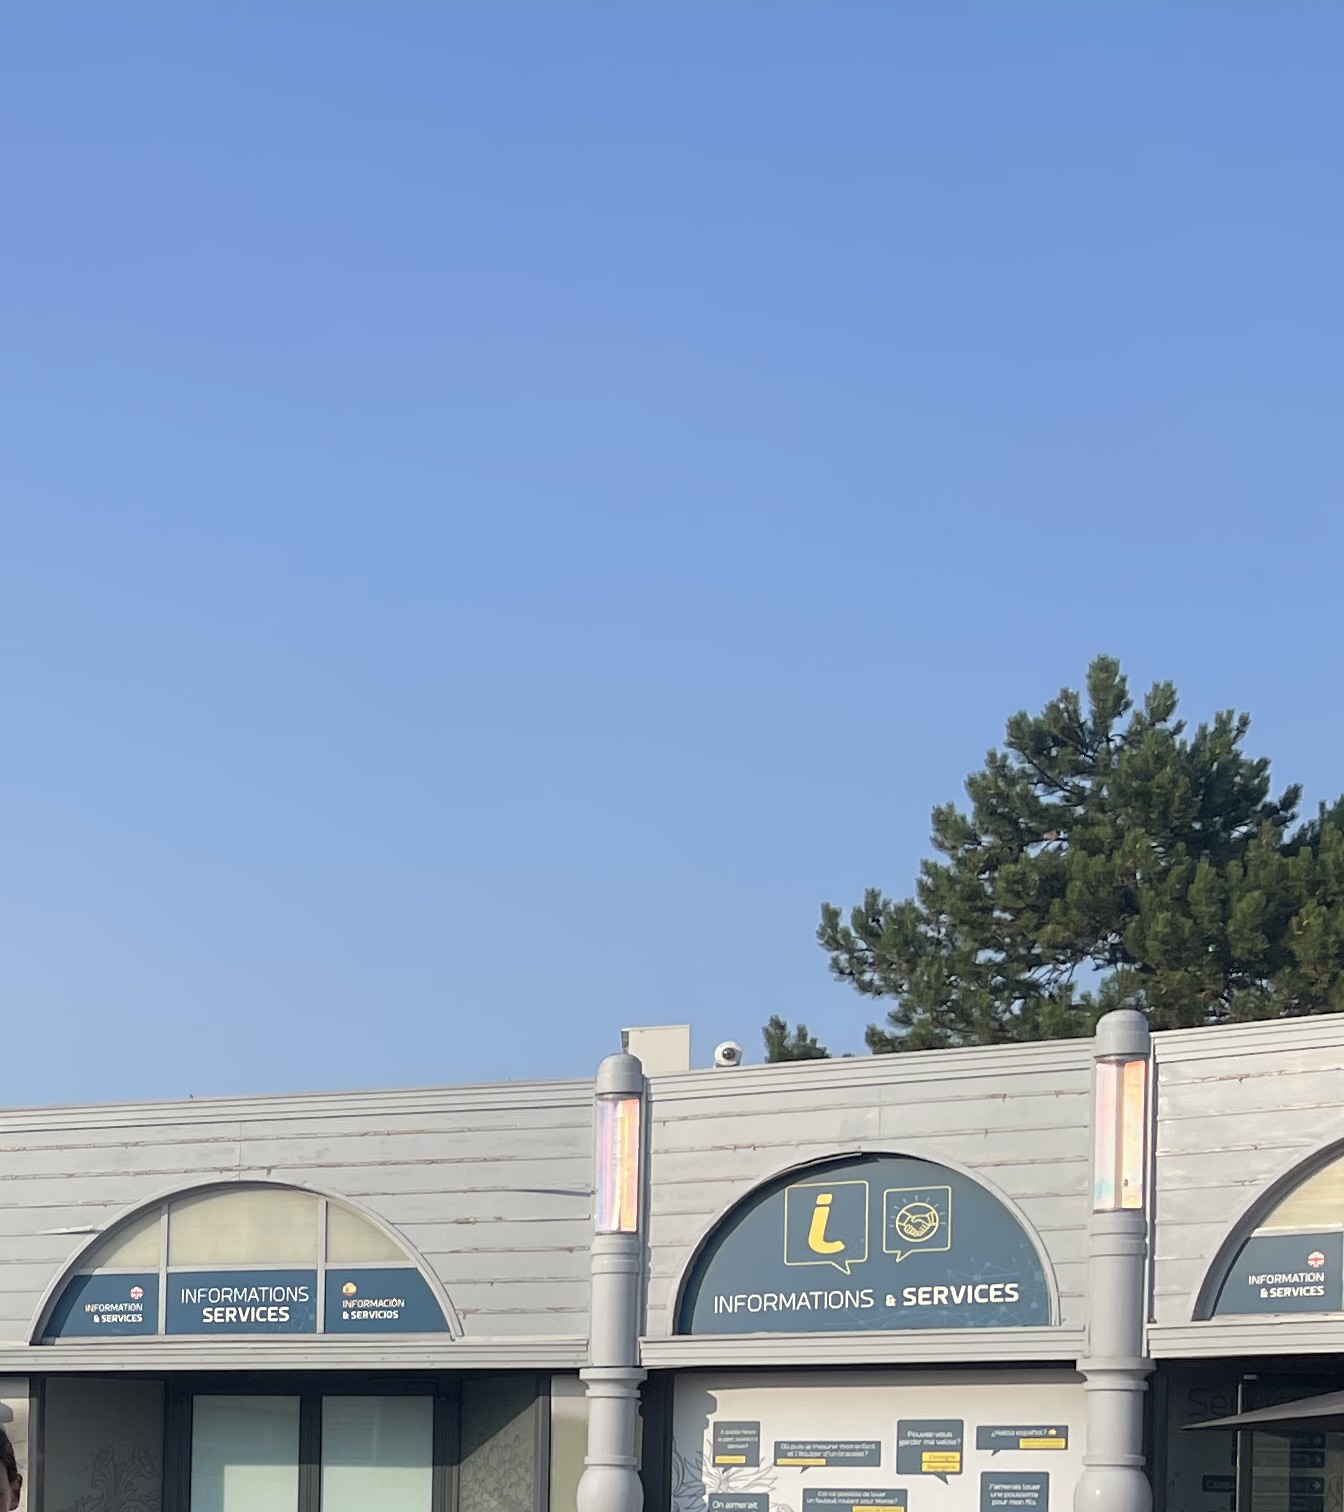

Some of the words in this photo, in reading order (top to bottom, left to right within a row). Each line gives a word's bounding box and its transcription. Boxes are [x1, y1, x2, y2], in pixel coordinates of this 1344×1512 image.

[1248, 1272, 1325, 1286] INFORMATION
[181, 1286, 310, 1304] INFORMATIONS
[1260, 1288, 1268, 1298] &
[1269, 1285, 1325, 1298] SERVICES
[342, 1298, 405, 1309] INFORMACIÓN
[714, 1289, 874, 1314] INFORMATIONS
[885, 1295, 896, 1306] &
[902, 1283, 1019, 1306] SERVICES
[84, 1303, 143, 1313] INFORMATION
[93, 1314, 100, 1323] &
[101, 1313, 143, 1323] SERVICES
[202, 1306, 290, 1323] SERVICES
[342, 1311, 349, 1319] &
[350, 1309, 399, 1320] SERVICIOS
[712, 1500, 724, 1508] On
[725, 1501, 758, 1509] aimerait
